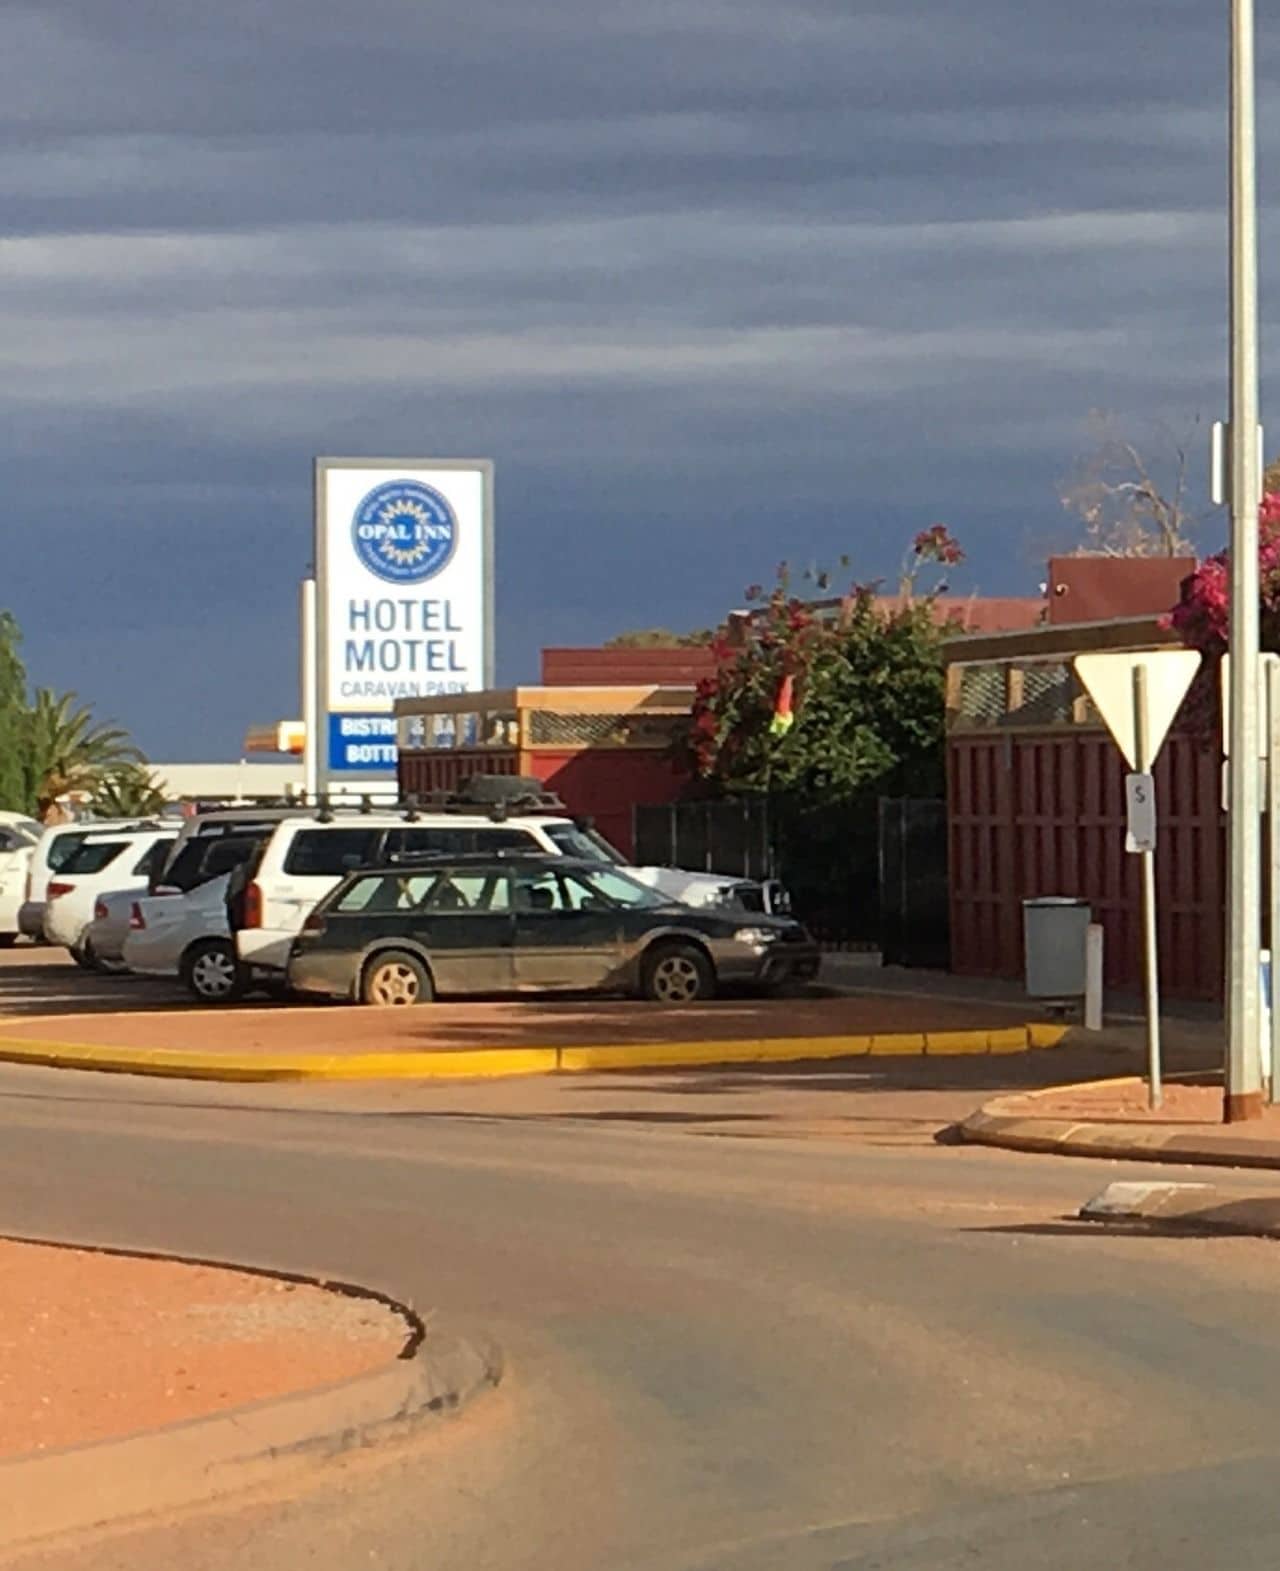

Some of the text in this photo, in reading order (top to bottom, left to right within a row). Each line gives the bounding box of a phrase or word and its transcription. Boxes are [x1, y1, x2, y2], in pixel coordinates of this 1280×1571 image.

[358, 523, 451, 540] OPAL INN
[349, 598, 462, 632] HOTEL
[345, 638, 467, 672] MOTEL
[341, 681, 469, 697] CARAVAN PARK
